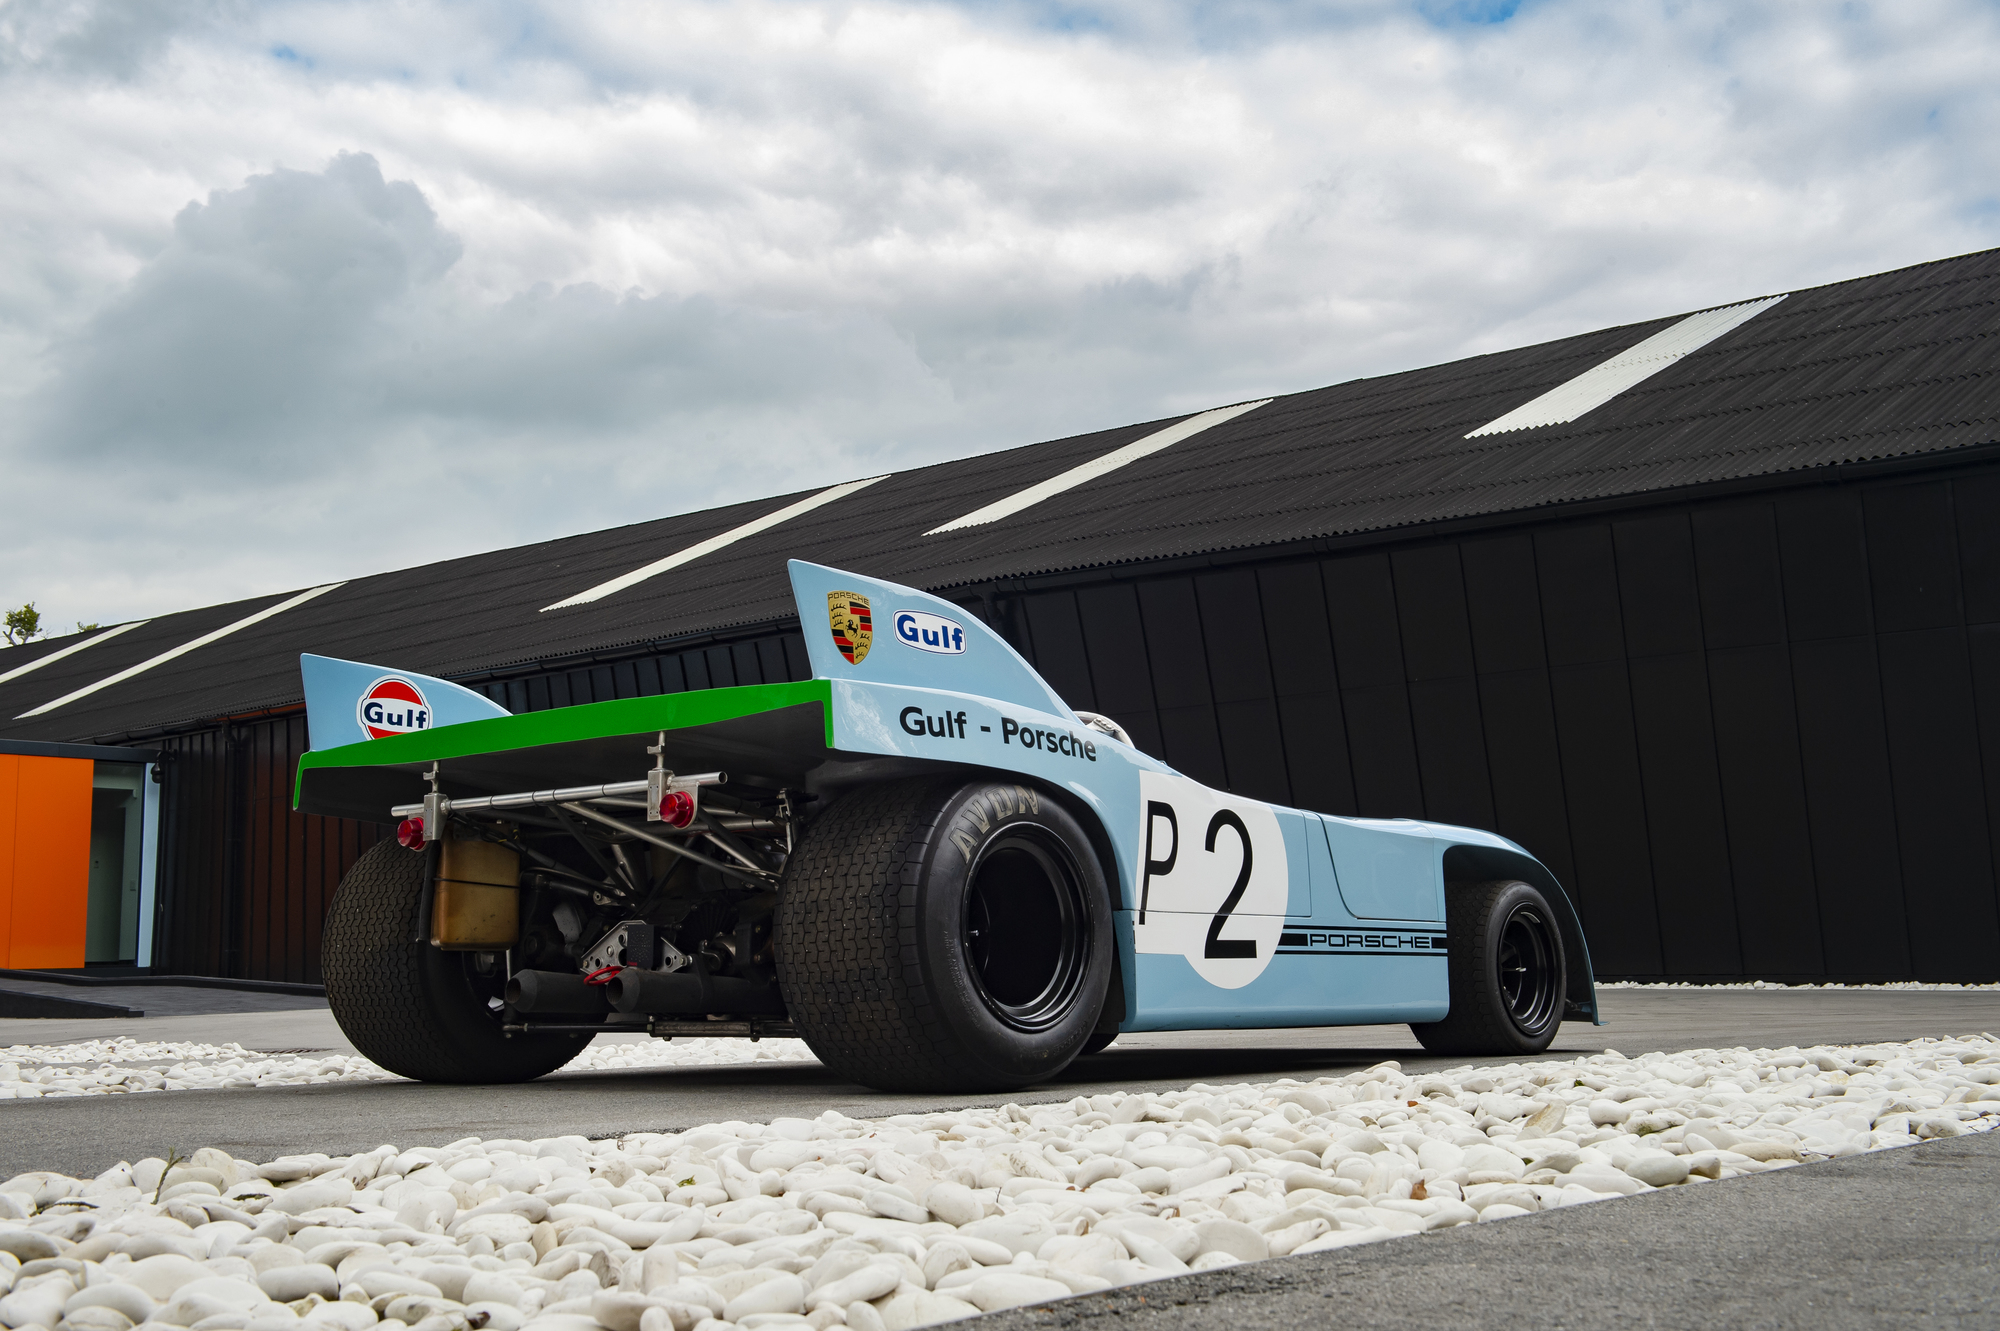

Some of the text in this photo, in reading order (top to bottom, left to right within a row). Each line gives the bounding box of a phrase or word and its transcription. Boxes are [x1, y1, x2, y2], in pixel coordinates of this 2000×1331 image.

[828, 591, 870, 607] PORSCHE
[896, 614, 963, 651] Gulf
[364, 701, 427, 729] Gulf
[900, 706, 967, 739] Gulf
[1001, 717, 1097, 762] Porsche
[949, 785, 1040, 865] AVON
[1204, 808, 1257, 959] 2
[1309, 933, 1430, 949] PORSCHE
